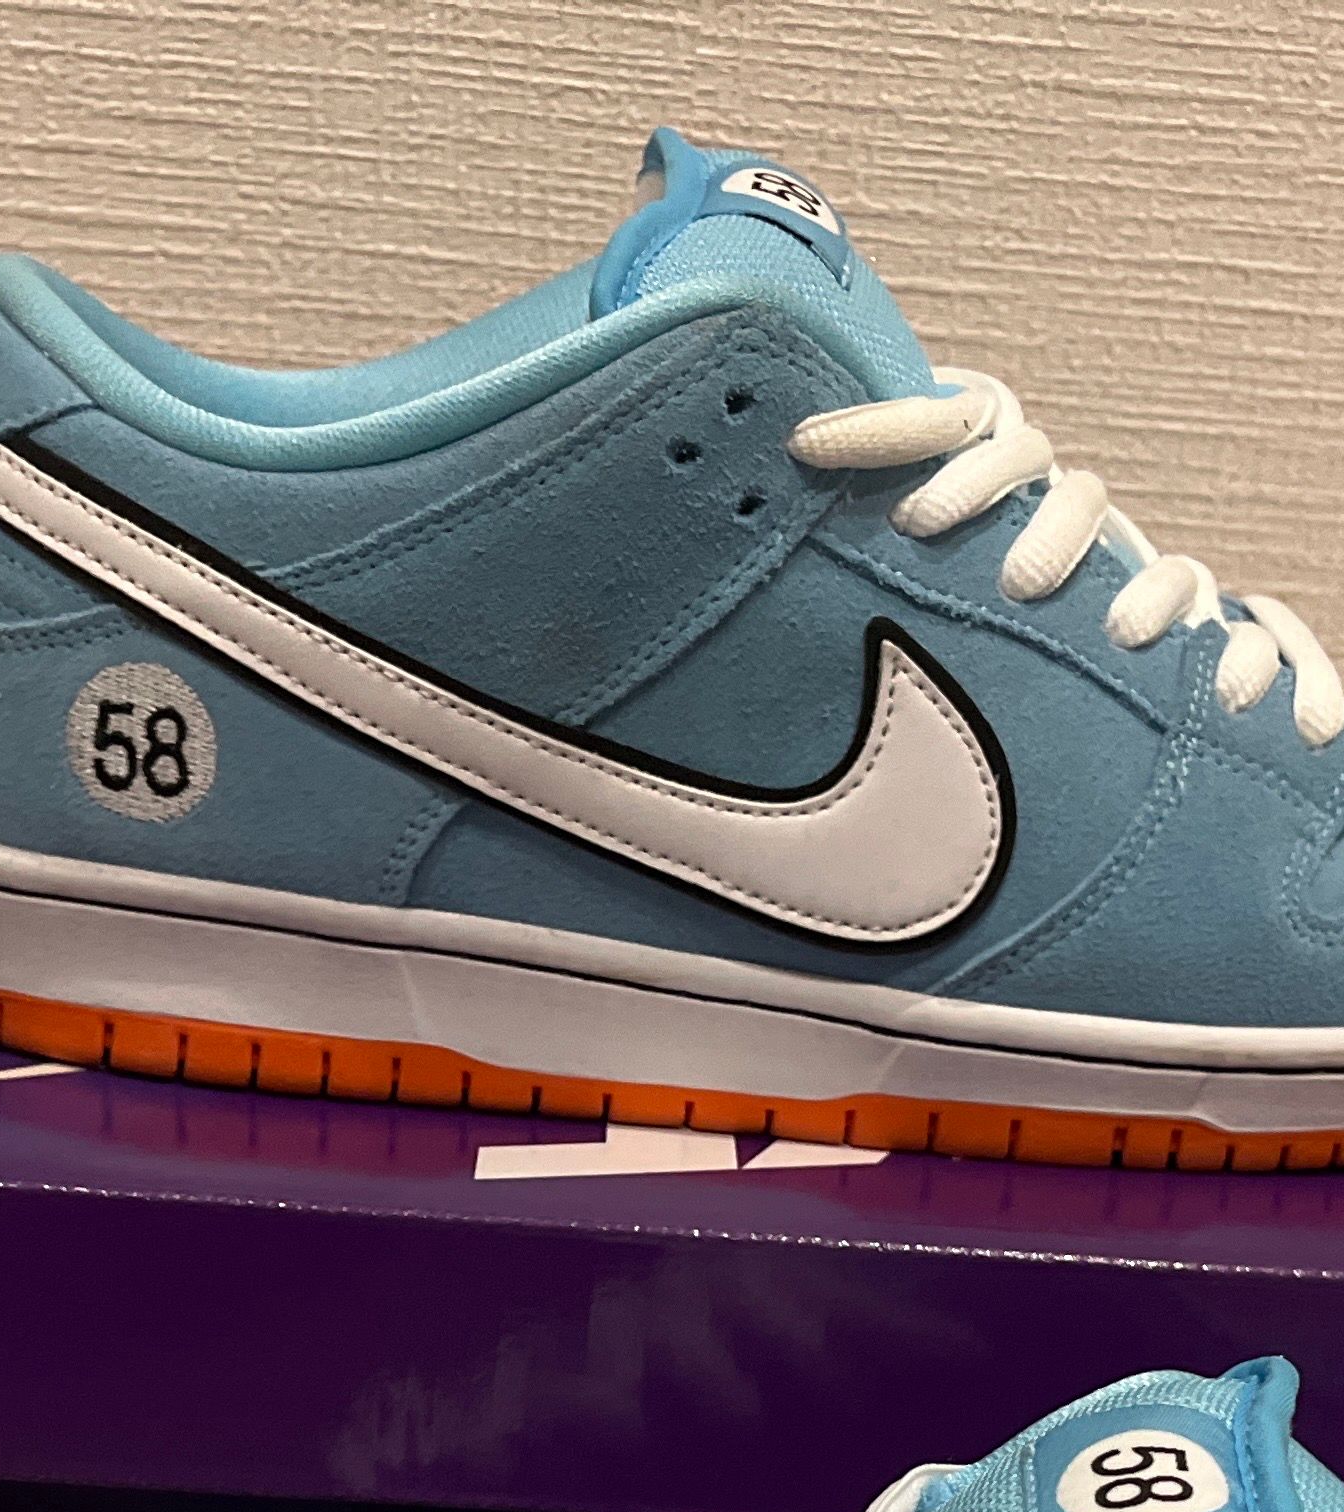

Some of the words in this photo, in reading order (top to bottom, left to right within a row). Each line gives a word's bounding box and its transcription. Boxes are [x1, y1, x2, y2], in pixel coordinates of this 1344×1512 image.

[751, 172, 821, 217] 58
[93, 700, 190, 797] 58
[1090, 1446, 1193, 1509] 58
